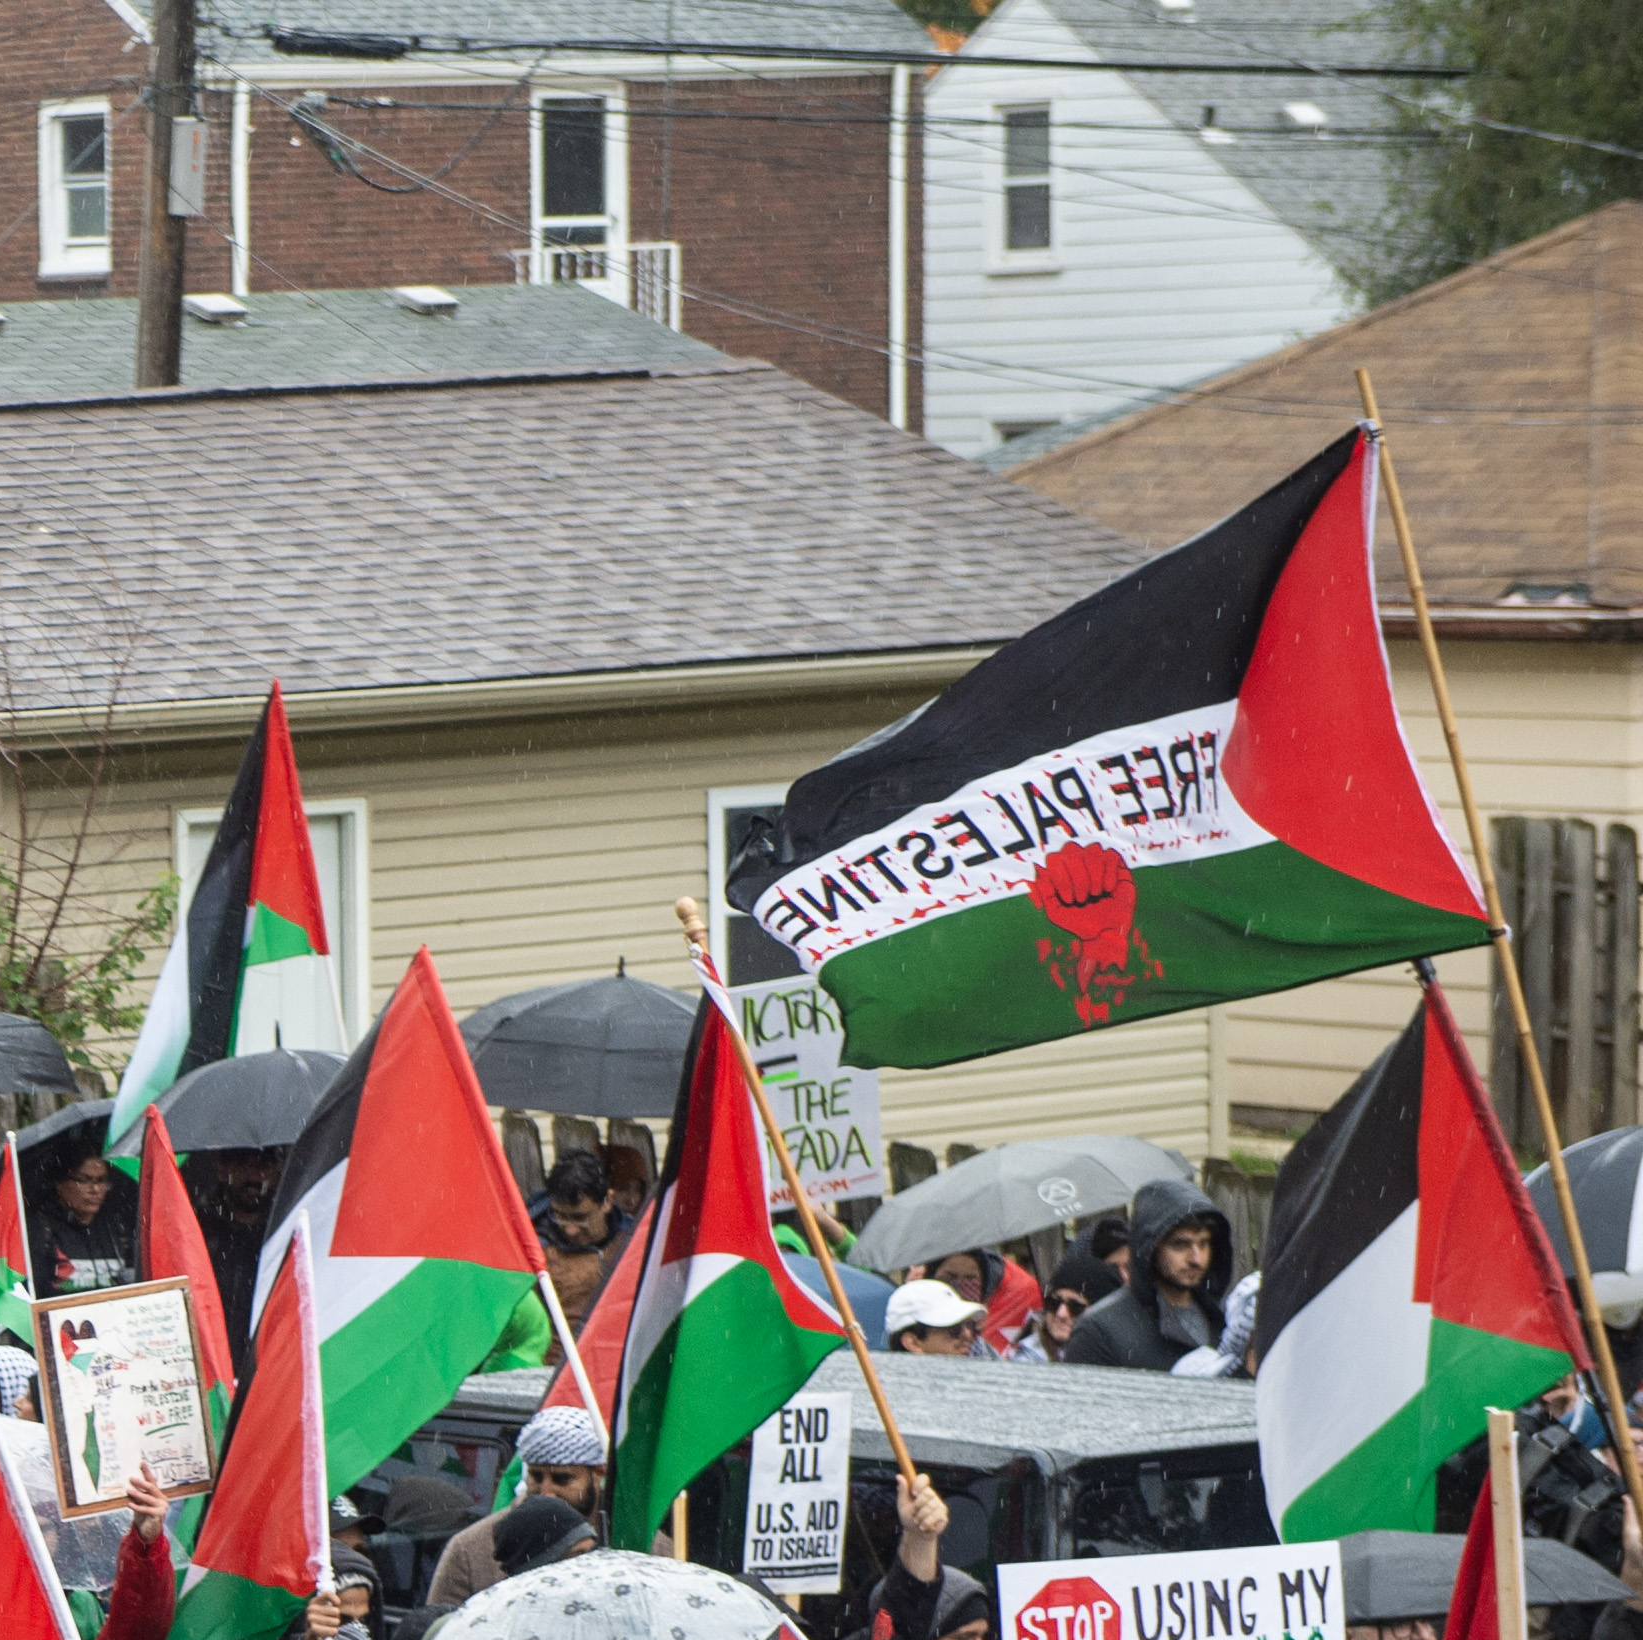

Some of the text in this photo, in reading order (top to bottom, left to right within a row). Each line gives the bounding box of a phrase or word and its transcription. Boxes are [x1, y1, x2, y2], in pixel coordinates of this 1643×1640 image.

[779, 1076, 852, 1122] THE
[769, 1124, 873, 1179] FADA
[779, 1407, 828, 1444] END
[779, 1447, 822, 1484] ALL
[756, 1500, 839, 1534] U.S. AID
[752, 1534, 838, 1561] TO ISRAEL!
[1278, 1566, 1330, 1629] MY
